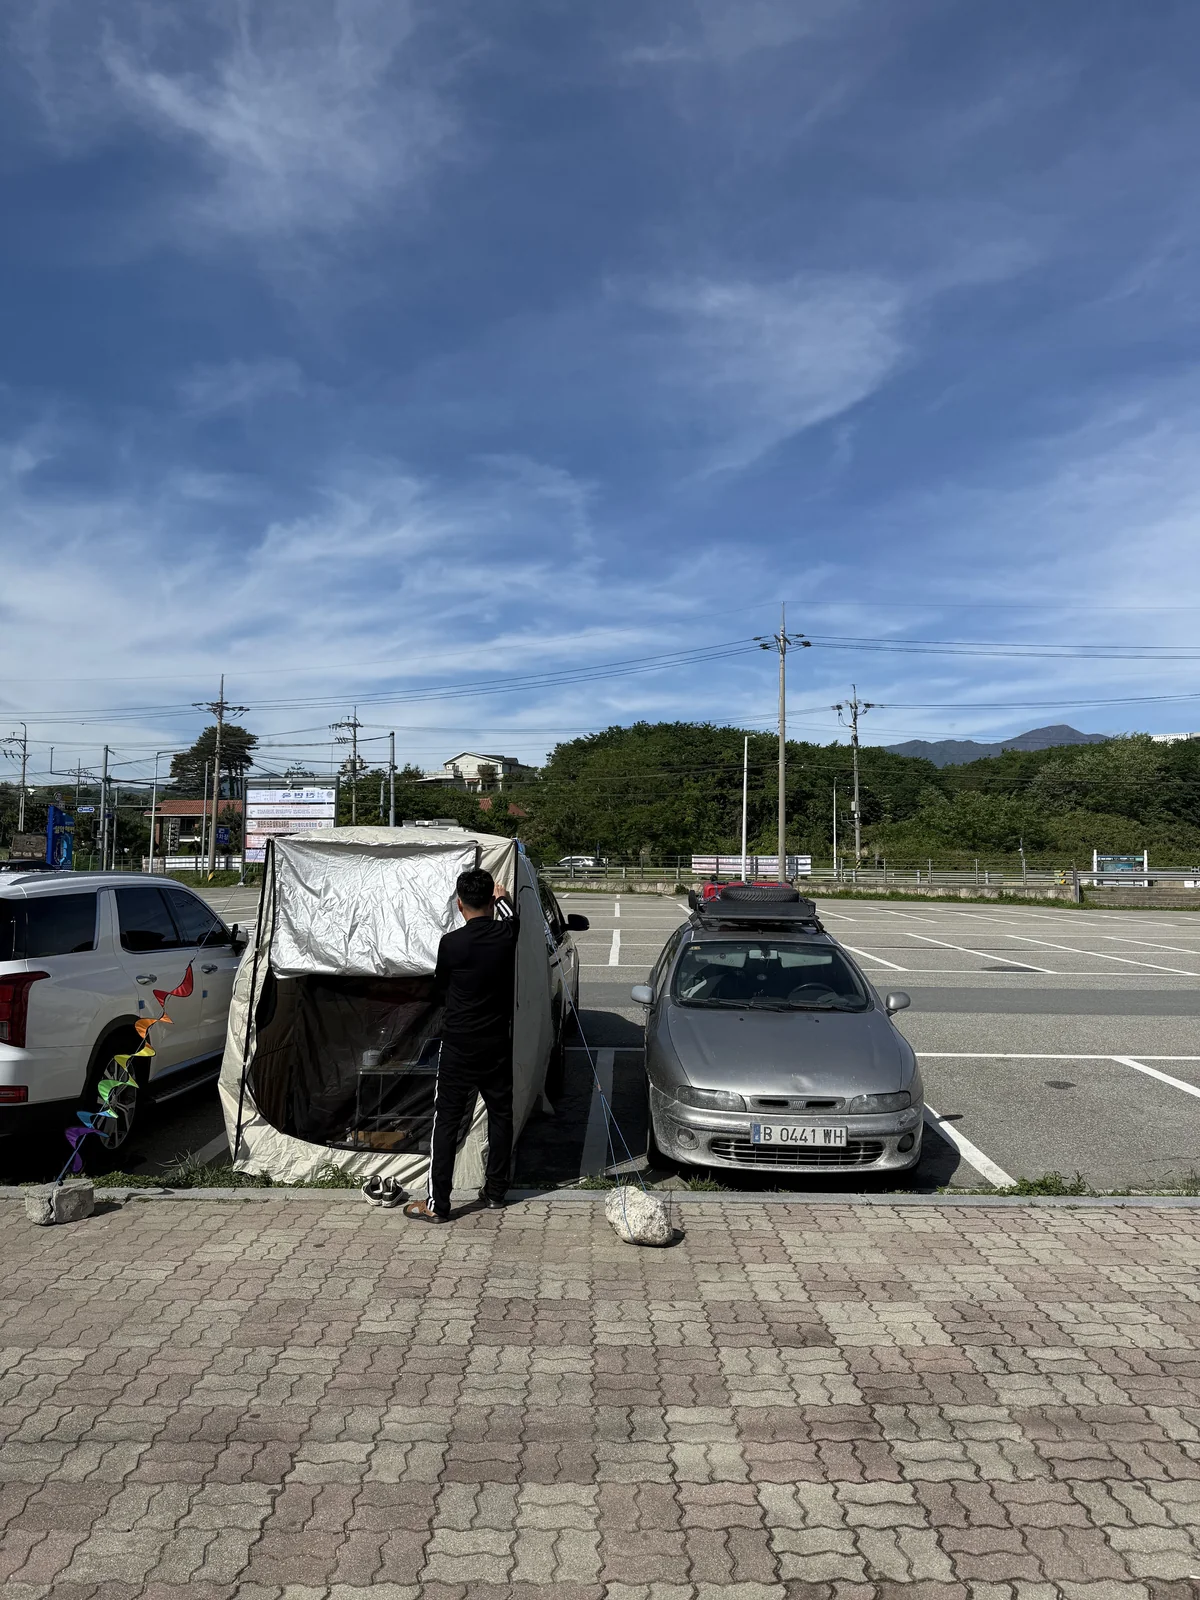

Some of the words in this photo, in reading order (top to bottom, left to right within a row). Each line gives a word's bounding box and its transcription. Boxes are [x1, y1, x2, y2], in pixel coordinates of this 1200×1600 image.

[763, 1126, 773, 1141] B
[780, 1127, 816, 1143] 0441
[823, 1129, 844, 1144] WH
